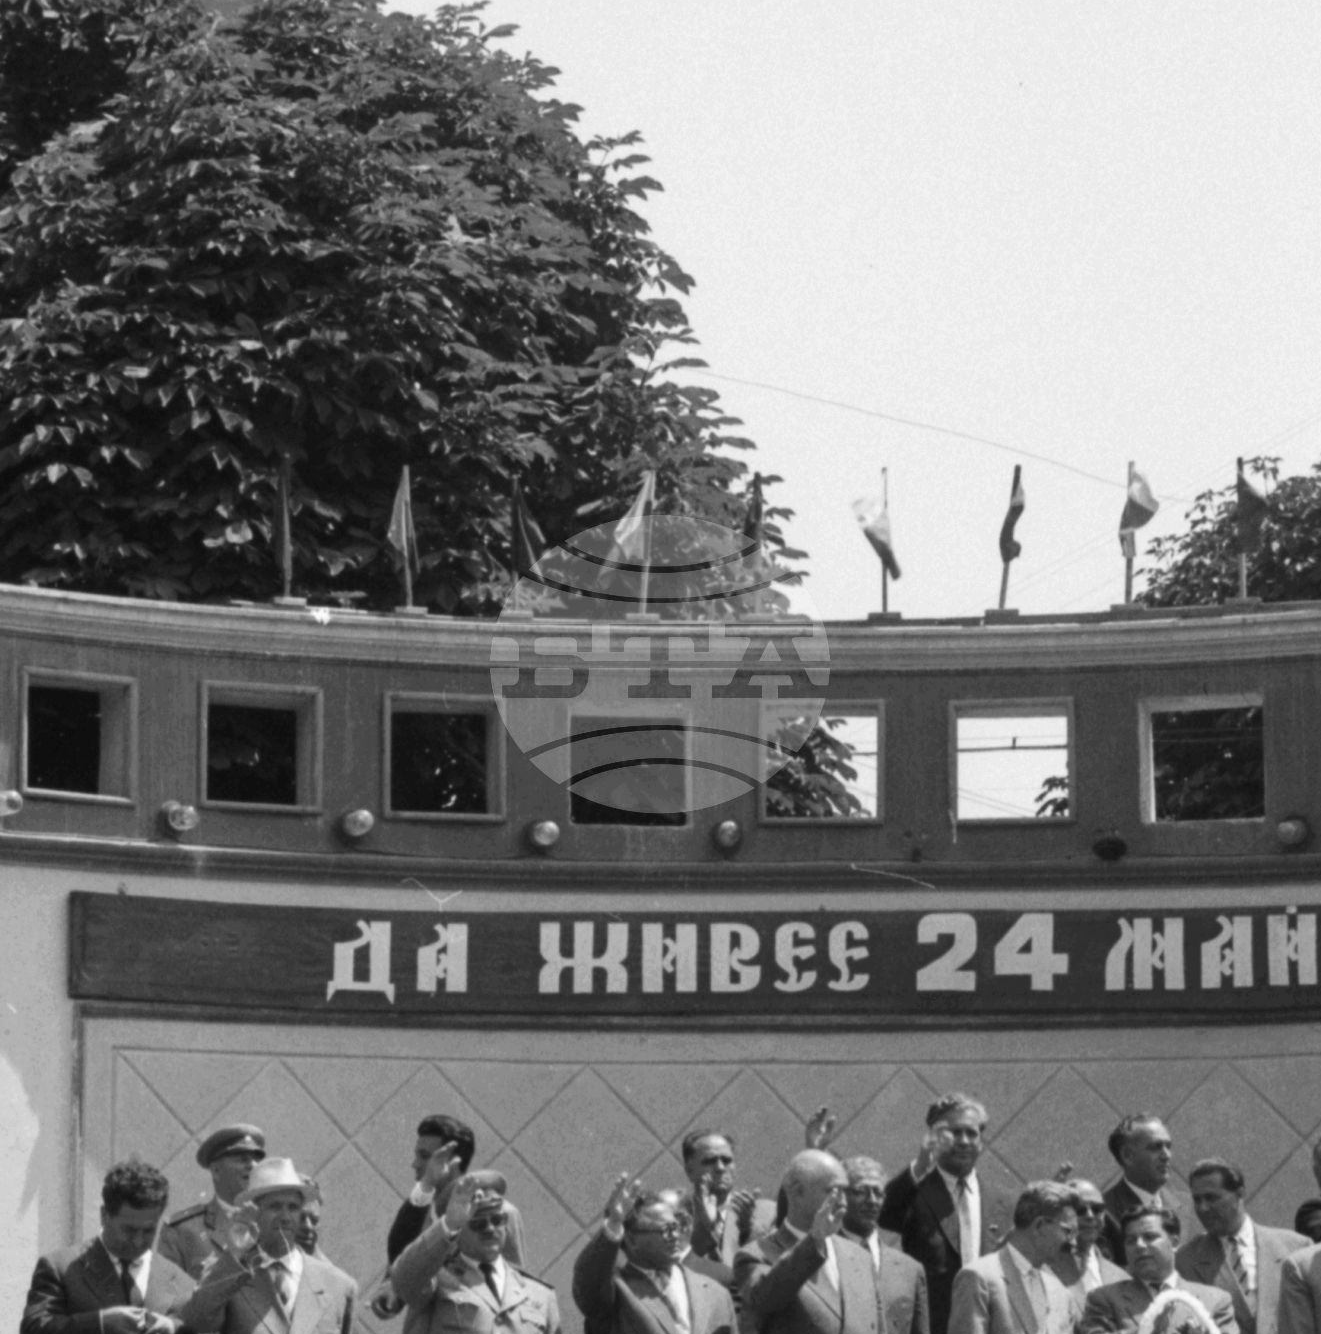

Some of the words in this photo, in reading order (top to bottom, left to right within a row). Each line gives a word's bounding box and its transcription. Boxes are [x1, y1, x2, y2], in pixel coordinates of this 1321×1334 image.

[326, 919, 469, 1005] ДА
[538, 920, 870, 994] ЖИВЕЕ
[916, 912, 1069, 992] 24
